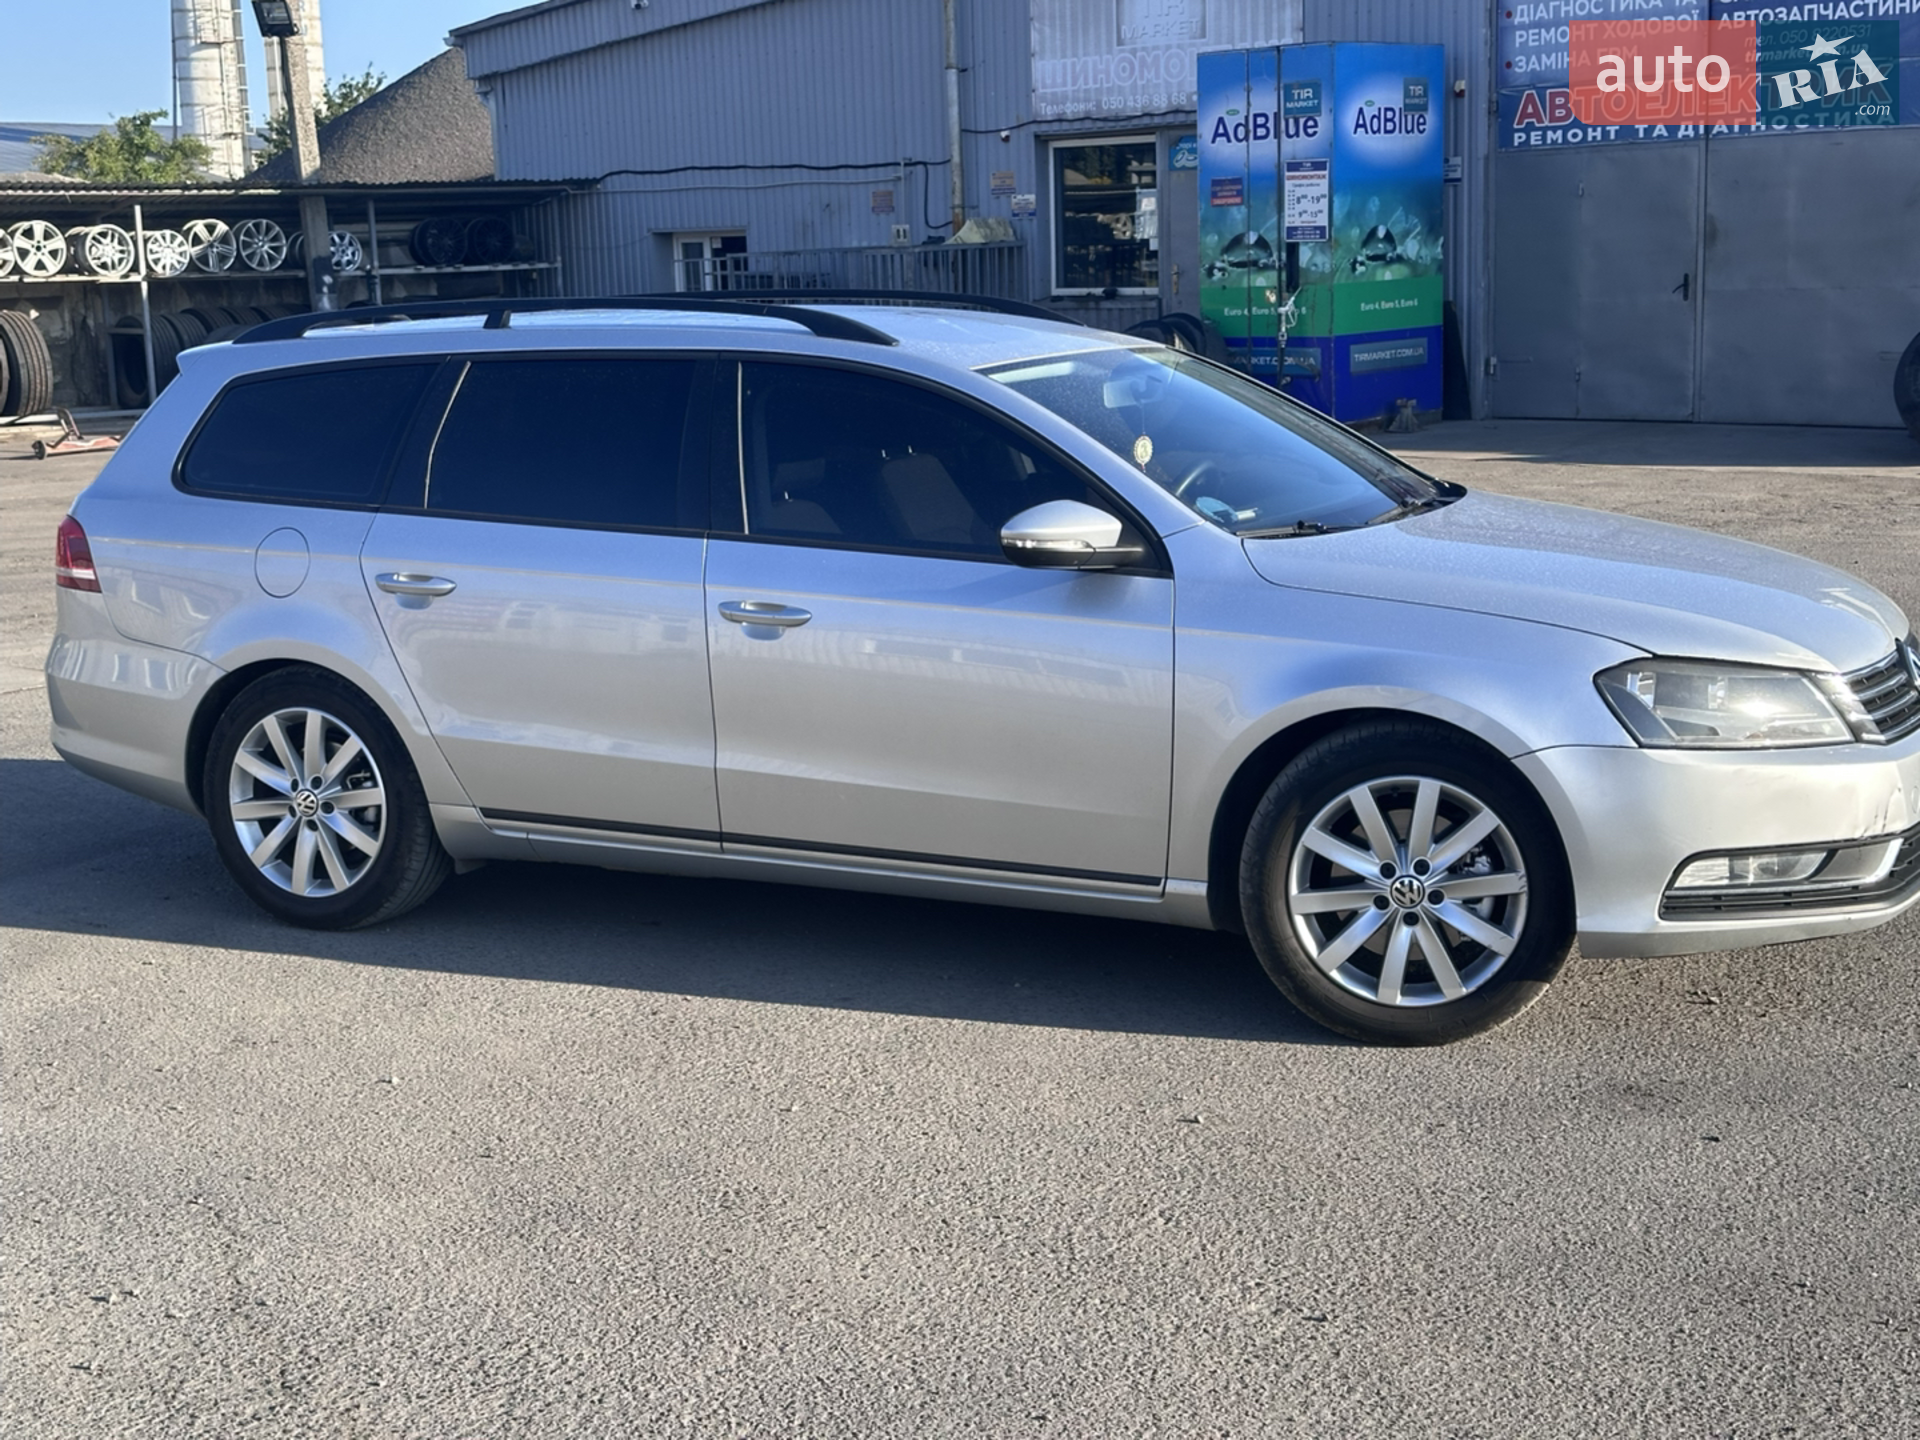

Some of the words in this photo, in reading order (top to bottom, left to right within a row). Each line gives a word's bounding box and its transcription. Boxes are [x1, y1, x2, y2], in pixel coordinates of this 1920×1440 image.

[1120, 19, 1200, 40] MARKET
[1515, 23, 1598, 48] РЕМОНТ
[1603, 9, 1699, 40] ХОДОВОЇ
[1779, 29, 1808, 45] 050
[1039, 44, 1233, 93] ШИНОМО
[1514, 49, 1592, 73] ЗАМІНА
[1292, 87, 1313, 100] TIR
[1409, 85, 1424, 97] TIR
[1040, 101, 1096, 116] Телефони:
[1102, 96, 1125, 110] 050
[1127, 95, 1150, 108] 436
[1171, 92, 1187, 106] 68
[1286, 99, 1319, 109] MARKET
[1211, 111, 1319, 144] AdBlue
[1353, 107, 1427, 135] AdBlue
[1514, 125, 1620, 146] РЕМОНТ
[1634, 122, 1669, 138] ТА
[1677, 108, 1896, 138] ДІАГНОСТИКА
[1224, 307, 1242, 316] Euro
[1252, 306, 1269, 316] Euro
[1360, 302, 1374, 312] Euro
[1381, 300, 1394, 310] Euro
[1401, 299, 1413, 308] Euro
[1354, 346, 1425, 362] TIRMARKET.COM.UA
